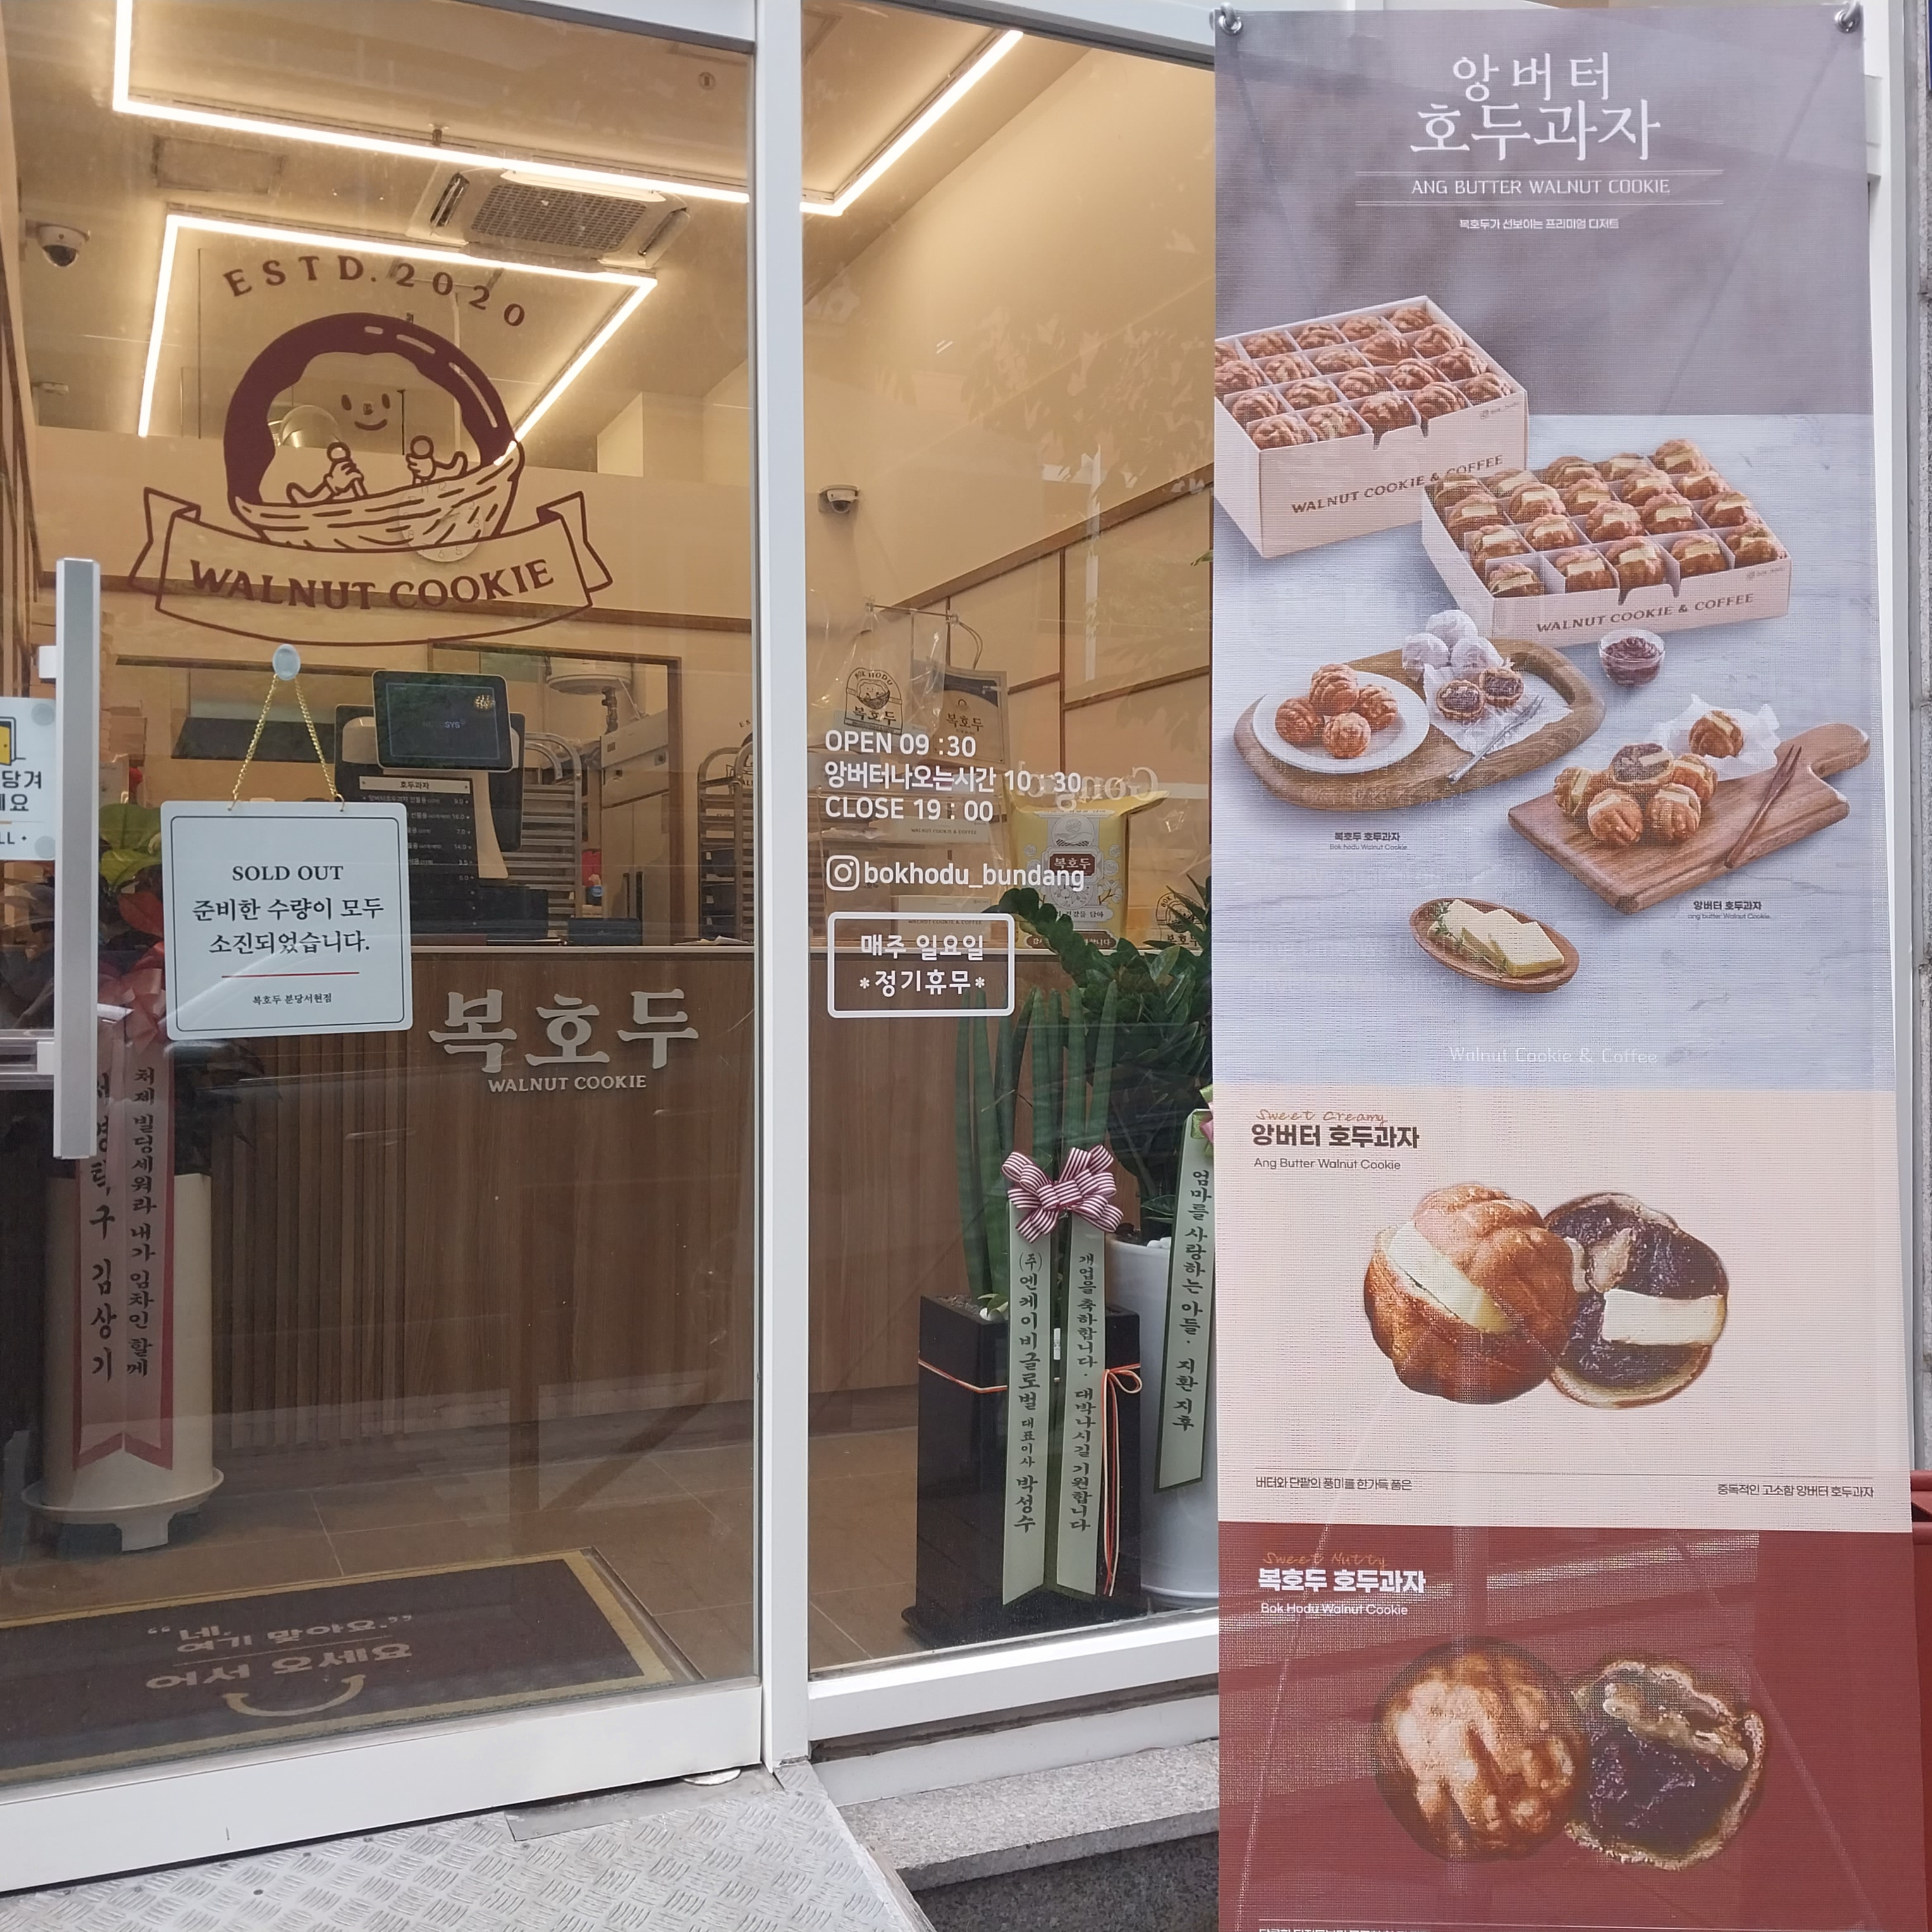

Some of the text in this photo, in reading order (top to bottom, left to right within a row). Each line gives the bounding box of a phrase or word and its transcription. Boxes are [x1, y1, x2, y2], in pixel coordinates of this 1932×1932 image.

[1453, 51, 1609, 102] 앙버터
[1410, 99, 1661, 161] 호두과자
[1411, 178, 1670, 195] ANG BUTTER WALNUT COOKIE
[1460, 218, 1620, 229] 복호두가 선보이는 프리미엄 디저트
[1292, 455, 1503, 514] WALNUT COOKIE & COFFEE
[190, 559, 554, 609] WALNUT COOKIE
[1536, 594, 1754, 633] WALNUT COOKIE & COFFEE
[825, 730, 892, 754] OPEN
[900, 733, 929, 755] 09
[2, 770, 42, 790] 당겨
[400, 781, 430, 790] 호두과자
[824, 761, 996, 793] 앙버터나오는시간
[825, 796, 904, 819] CLOSE
[914, 798, 941, 820] 19
[964, 800, 994, 821] 00
[1335, 831, 1400, 841] 복호두 호두과자
[232, 865, 344, 881] SOLD OUT
[1054, 857, 1092, 870] 복호두
[864, 861, 1085, 892] bokhodu_bundang
[192, 898, 384, 922] 준비한 수량이 모두
[1725, 901, 1762, 910] 호두과자
[209, 931, 370, 955] 소진되었습니다.
[861, 934, 984, 962] 매주 일요일
[253, 993, 333, 1006] 복호두 분당서현점
[428, 988, 699, 1073] 복호두
[1449, 1046, 1507, 1062] Walnut
[1516, 1047, 1572, 1063] Cookie
[1602, 1048, 1658, 1063] Coffee
[488, 1075, 647, 1092] WALNUT COOKIE
[1256, 1108, 1388, 1128] Sweet Creamy
[1251, 1123, 1421, 1149] 앙버터 호두과자
[1254, 1158, 1401, 1170] Ang Butter Walnut Cookie
[1187, 1169, 1212, 1221] 엄마를
[126, 1067, 157, 1378] 처제 빌딩세워라 내가 임차인 할께
[1181, 1226, 1208, 1295] 사랑하는
[1078, 1252, 1097, 1295] 개업을
[92, 1259, 117, 1383] 김상기
[1175, 1358, 1199, 1393] 지환
[1072, 1387, 1097, 1458] 대박나시길
[1172, 1398, 1194, 1432] 지후
[1020, 1417, 1036, 1468] 대표이사
[1256, 1476, 1288, 1488] 버터와
[1324, 1477, 1355, 1490] 풍미를
[1357, 1478, 1388, 1490] 한가득
[1391, 1479, 1413, 1491] 품은
[1718, 1484, 1874, 1498] 중독적인 고소함 앙버터 호두과자
[1013, 1474, 1039, 1534] 박성수
[1070, 1462, 1093, 1533] 기원합니다
[1258, 1568, 1426, 1593] 복호두 호두과자
[1261, 1603, 1409, 1615] Bok Hodu Walnut Cookie
[177, 1635, 252, 1653] 여기
[146, 1643, 413, 1689] 어서 오세요
